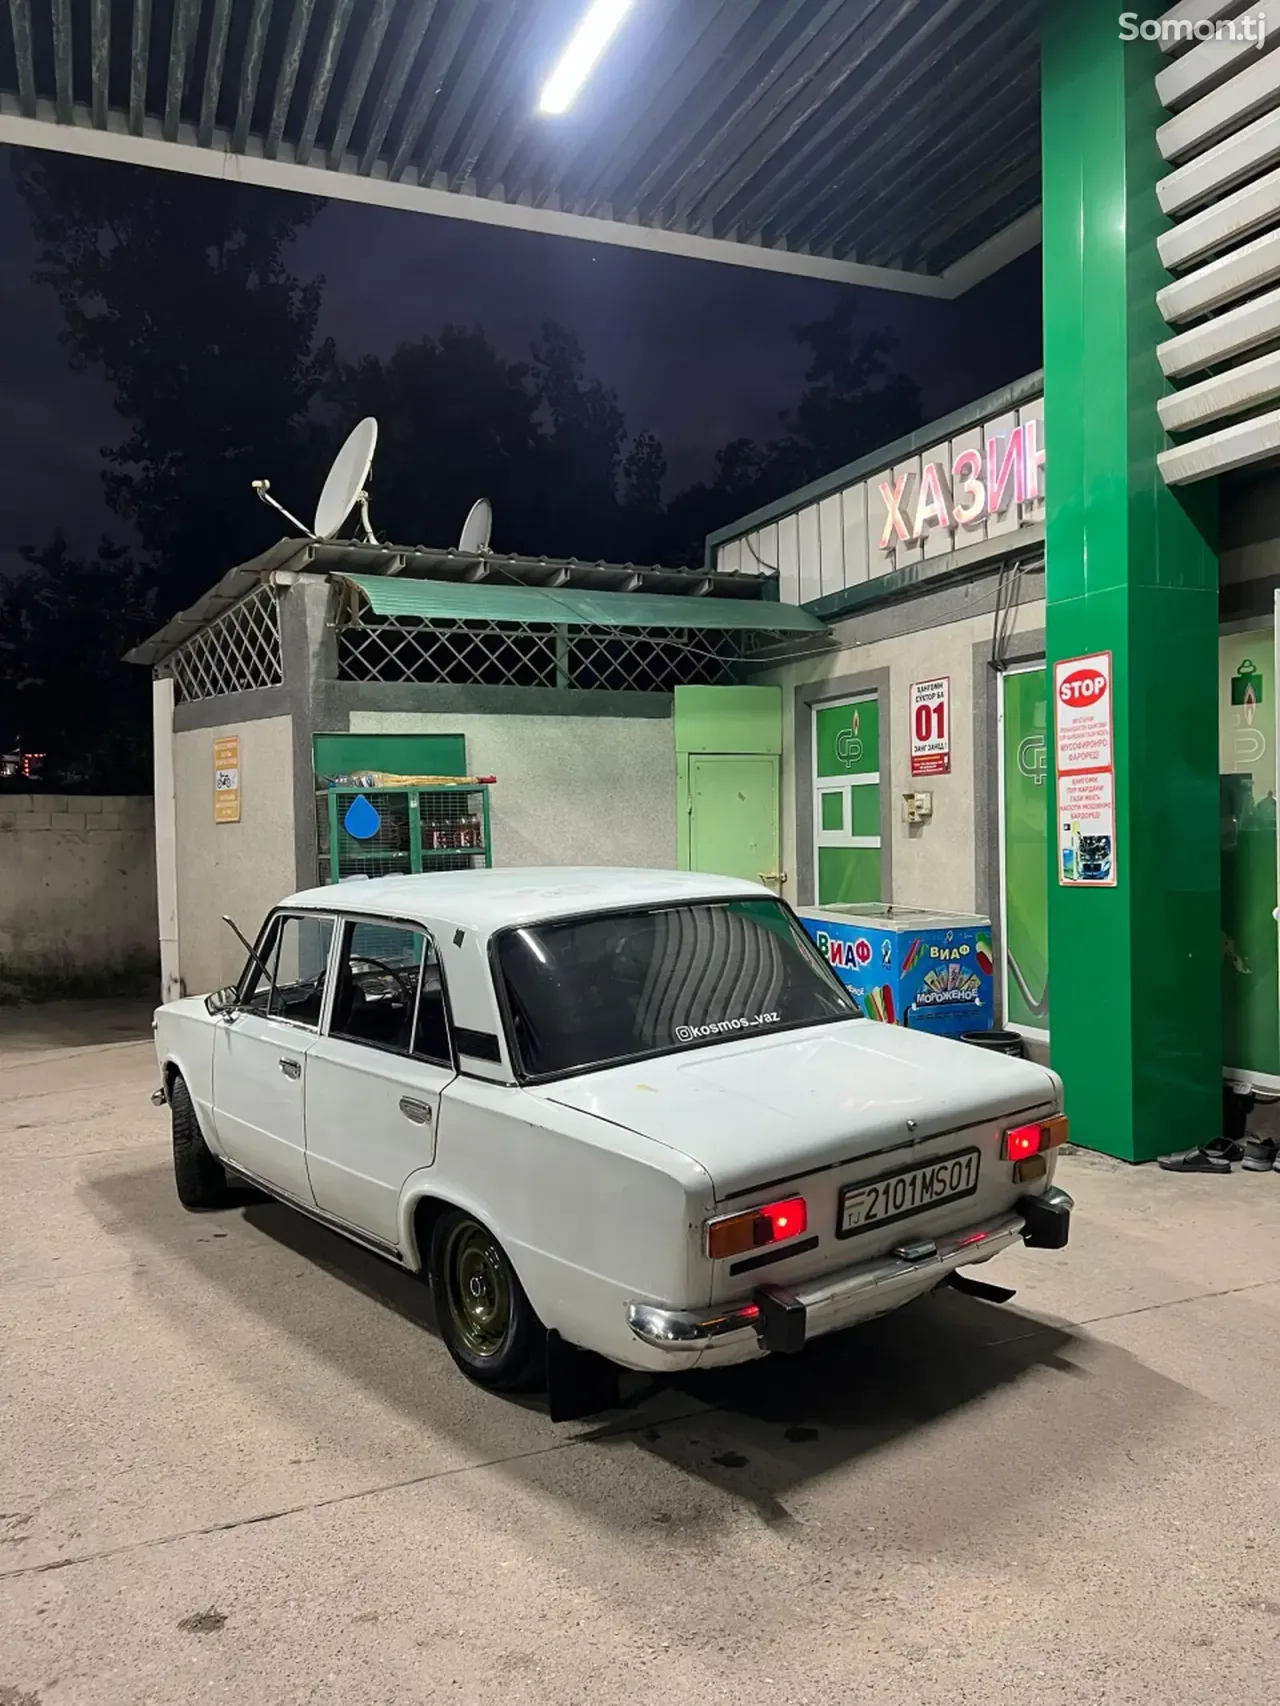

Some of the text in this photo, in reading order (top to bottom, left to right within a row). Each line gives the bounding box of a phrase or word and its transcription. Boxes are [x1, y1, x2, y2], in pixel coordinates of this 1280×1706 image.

[1061, 676, 1105, 700] STOP
[915, 700, 945, 742] 01
[816, 931, 872, 971] ВИАФ
[930, 944, 970, 960] ВИАФ
[916, 988, 979, 1003] МОРОЖЕНОЕ
[690, 1012, 781, 1038] kosmos_vaz
[864, 1156, 973, 1221] 2101MS01
